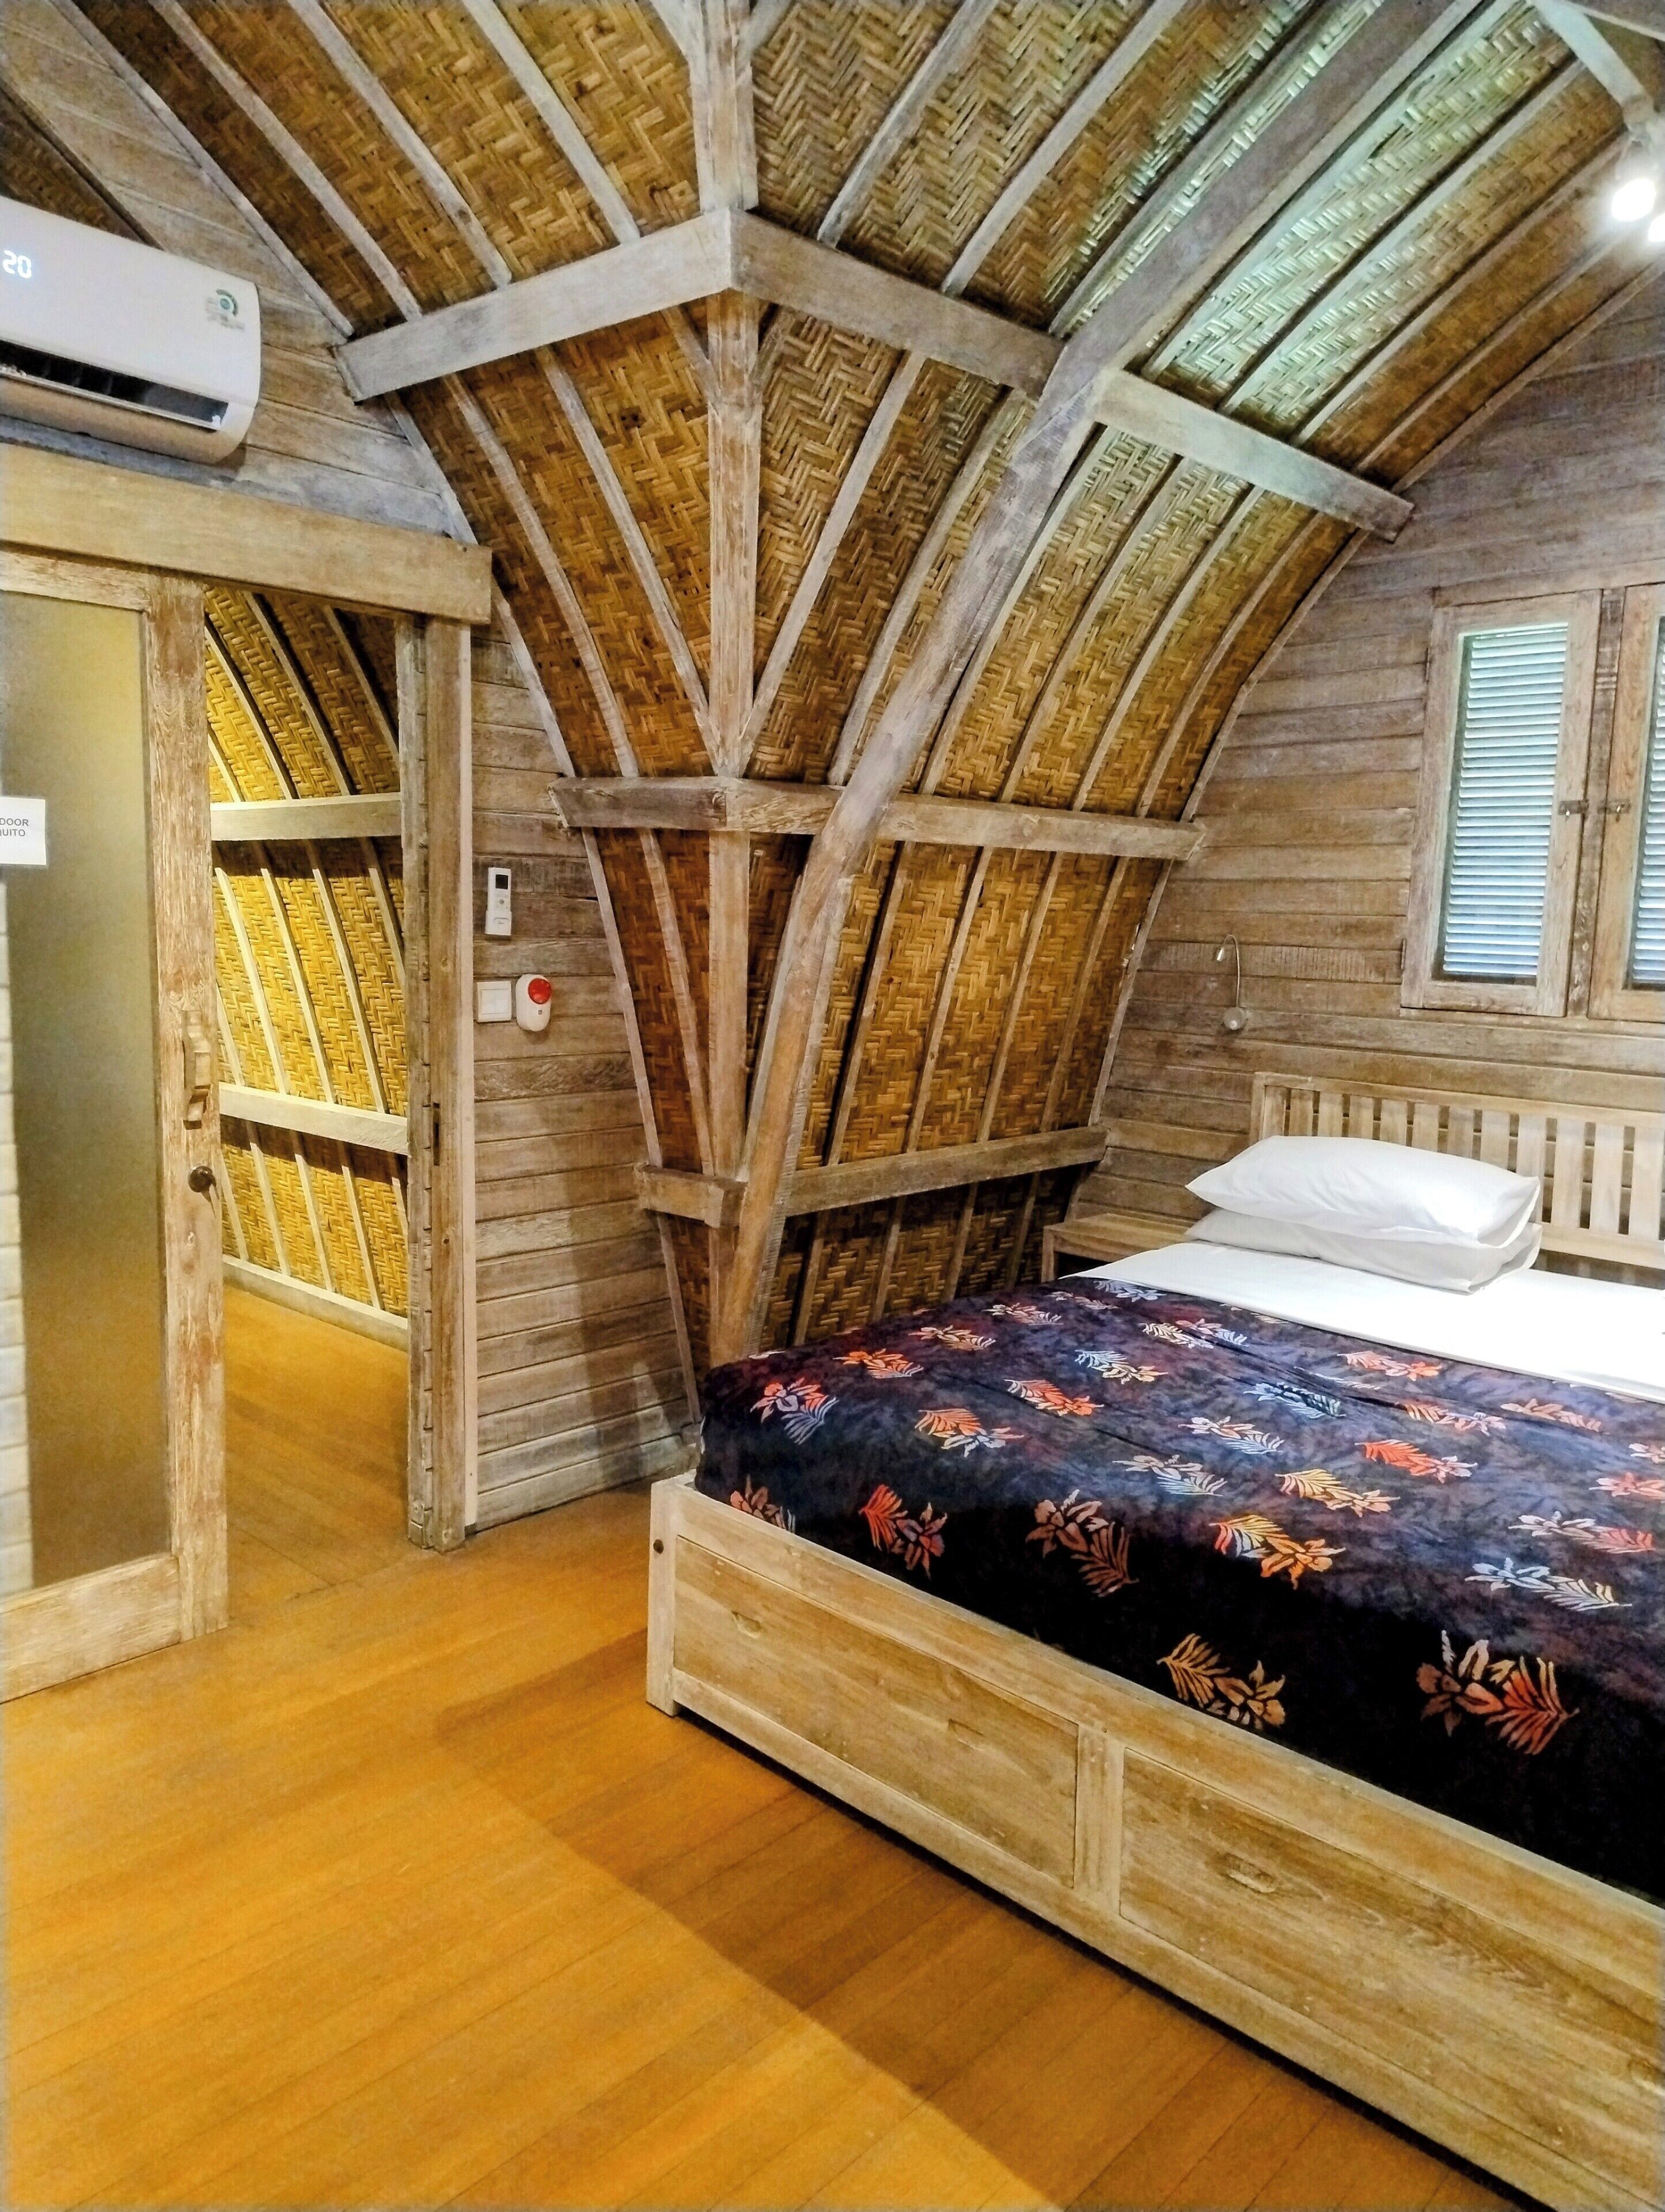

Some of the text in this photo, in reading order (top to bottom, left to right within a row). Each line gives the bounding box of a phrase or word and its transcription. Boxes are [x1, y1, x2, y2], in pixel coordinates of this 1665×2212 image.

[2, 250, 32, 279] 20
[0, 818, 29, 826] DOOR
[0, 828, 25, 836] UITO
